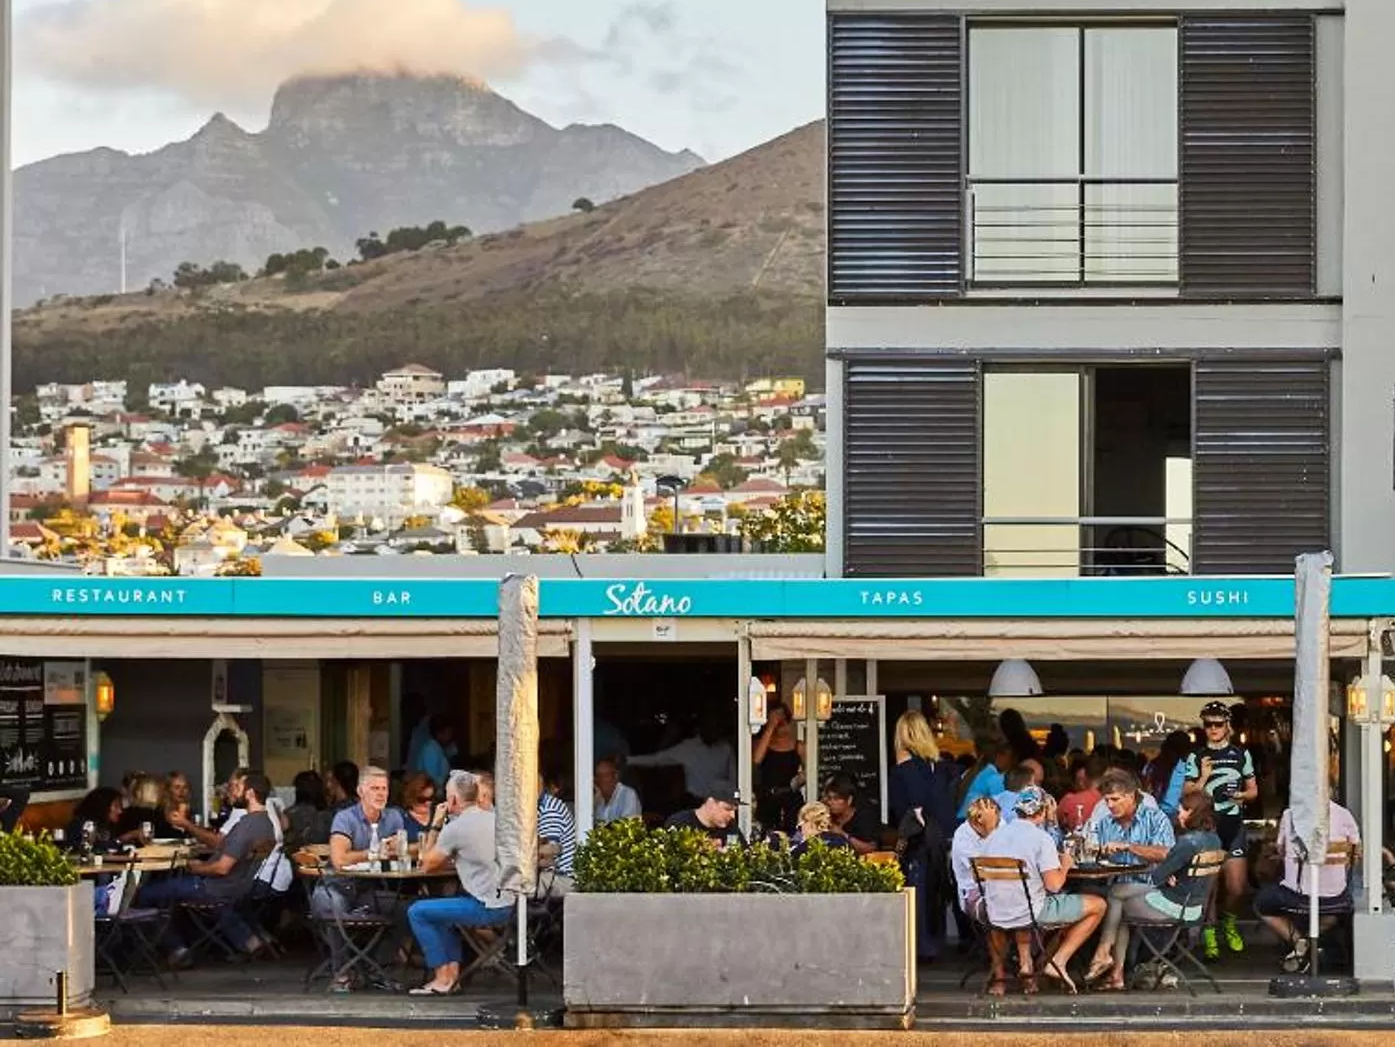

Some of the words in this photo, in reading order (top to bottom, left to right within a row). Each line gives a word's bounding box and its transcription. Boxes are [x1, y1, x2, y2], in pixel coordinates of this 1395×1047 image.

[52, 588, 186, 603] RESTAURANT
[373, 591, 411, 604] BAR
[603, 581, 692, 615] Sotano
[861, 591, 923, 604] TAPAS
[1187, 591, 1249, 604] SUSHI
